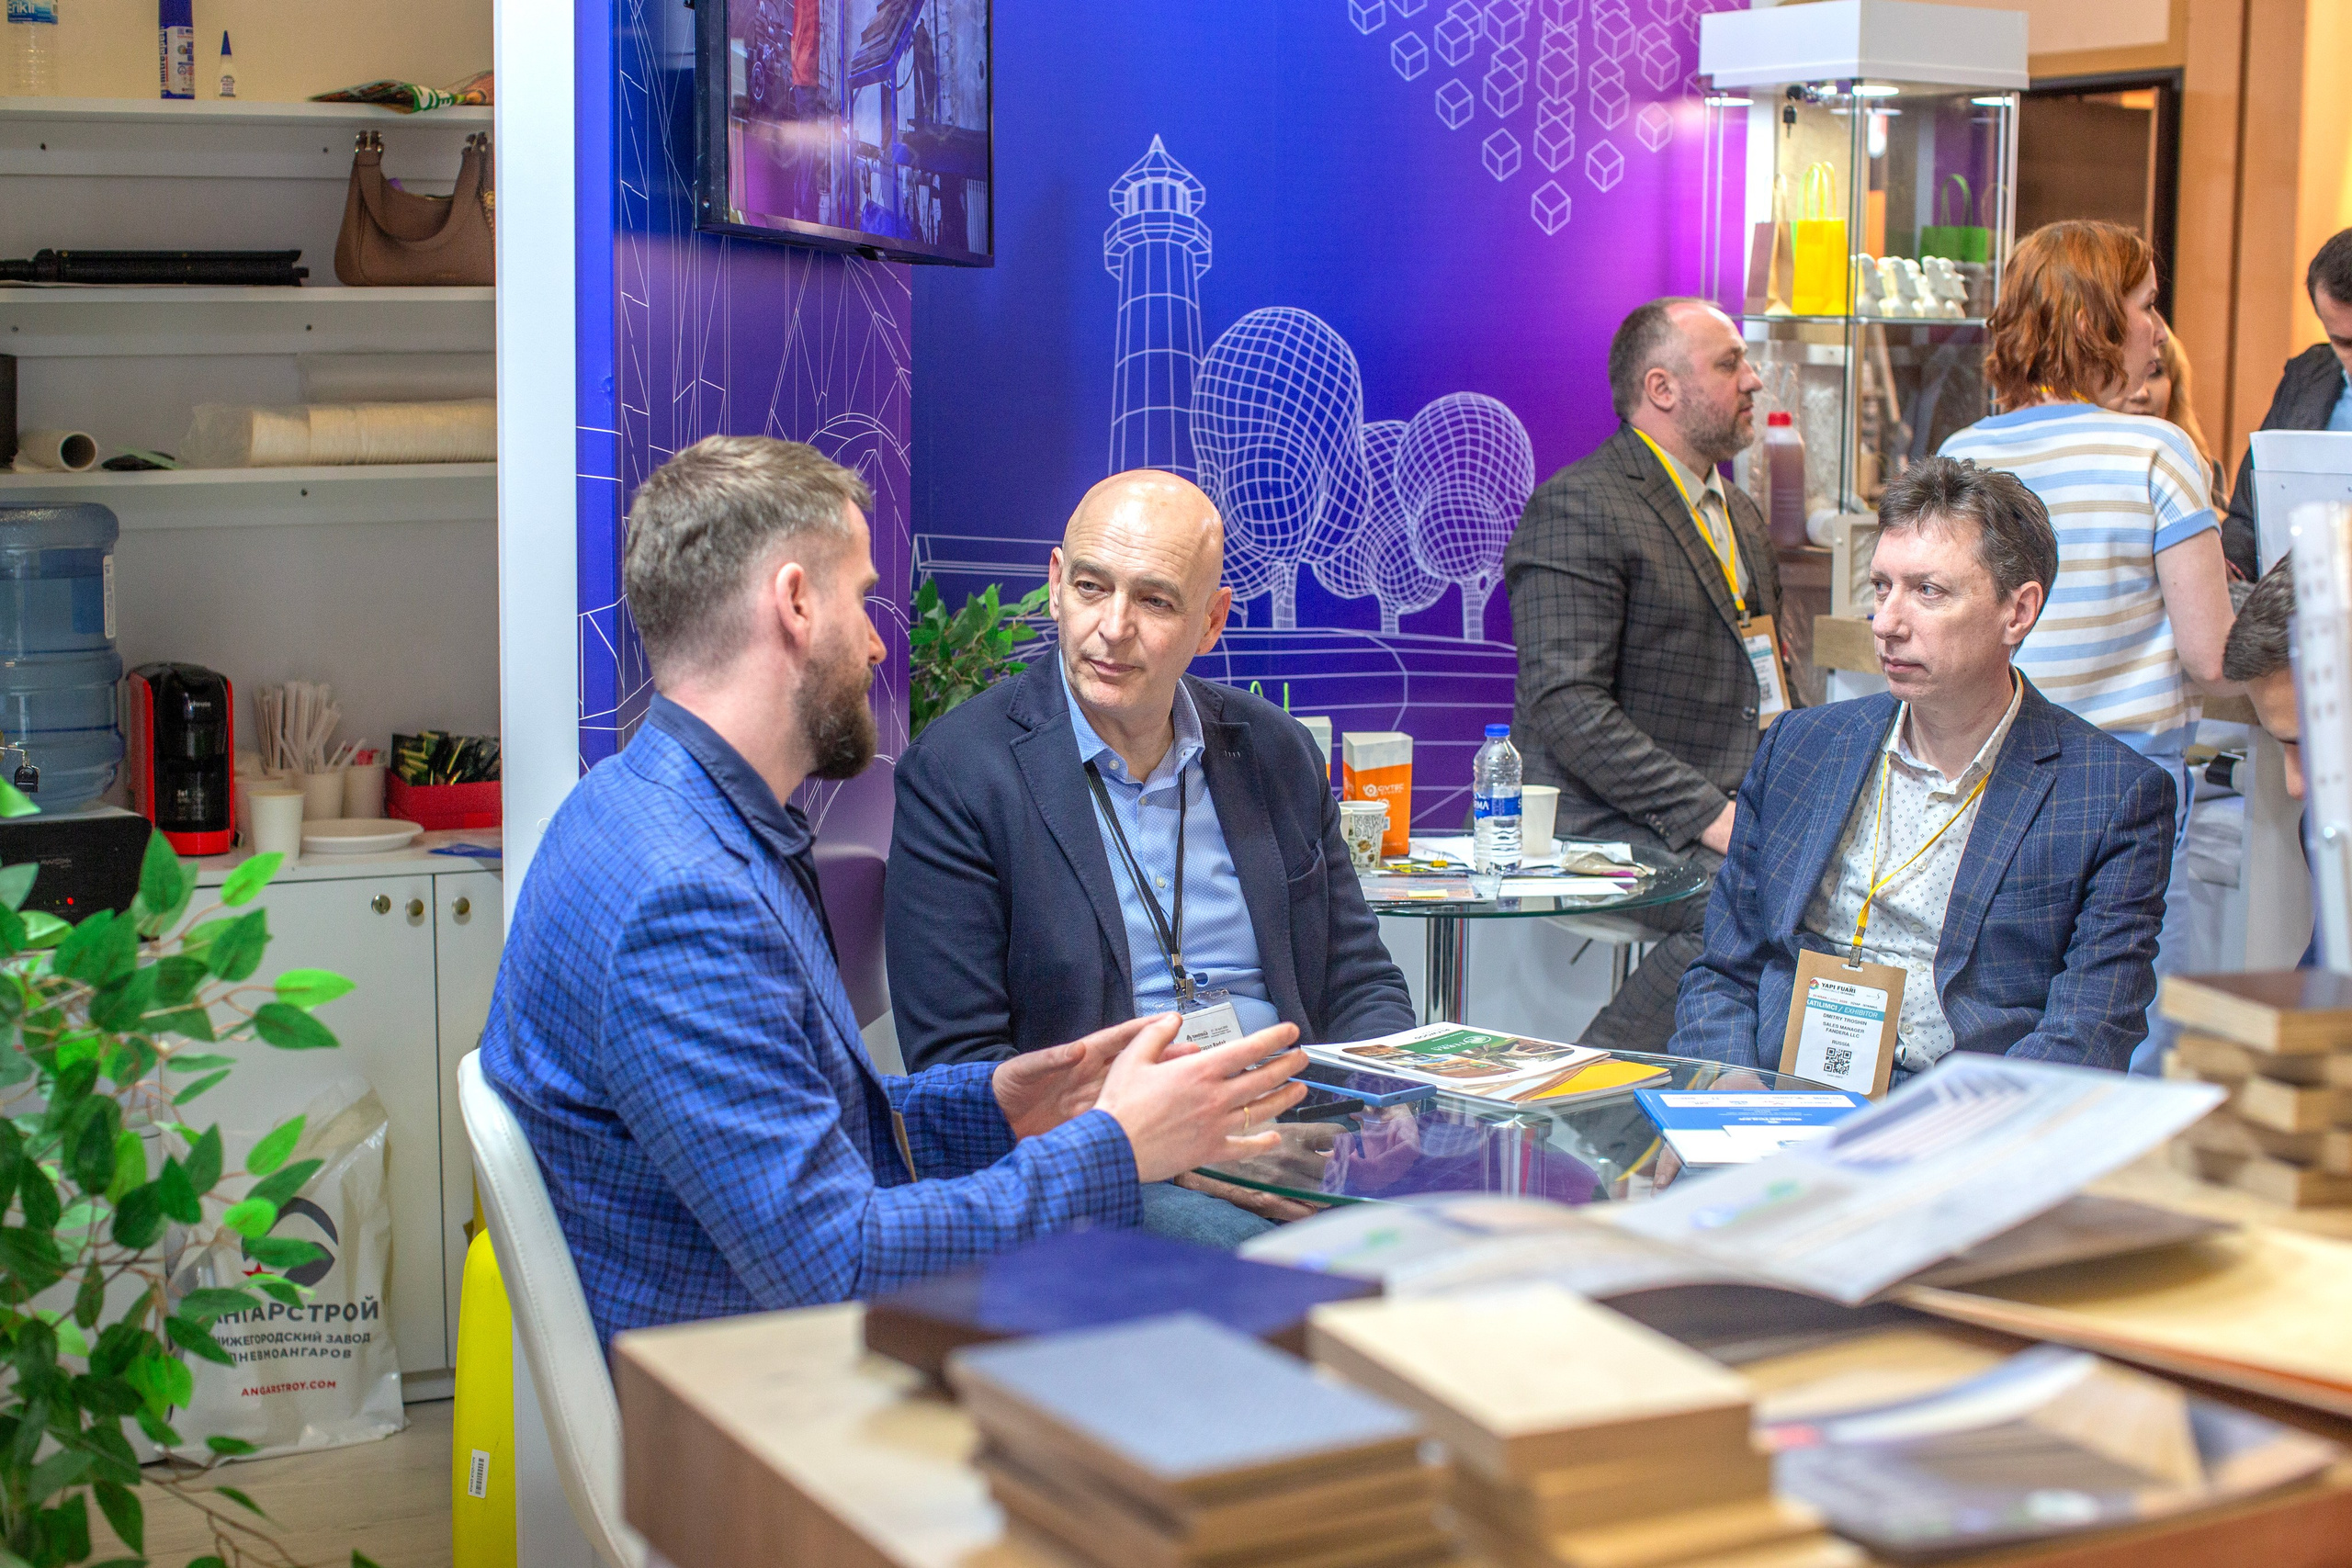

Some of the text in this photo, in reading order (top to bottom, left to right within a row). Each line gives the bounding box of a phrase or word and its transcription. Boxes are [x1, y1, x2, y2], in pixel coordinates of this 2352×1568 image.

[1821, 982, 1836, 990] YAPI
[1844, 1007, 1879, 1019] EXHIBITOR
[1823, 1012, 1868, 1026] DMITRY TROSHIN
[1839, 1025, 1865, 1033] MANAGER
[325, 1333, 371, 1344] ЗАВОД
[241, 1380, 336, 1396] ANGARSTROY.COM
